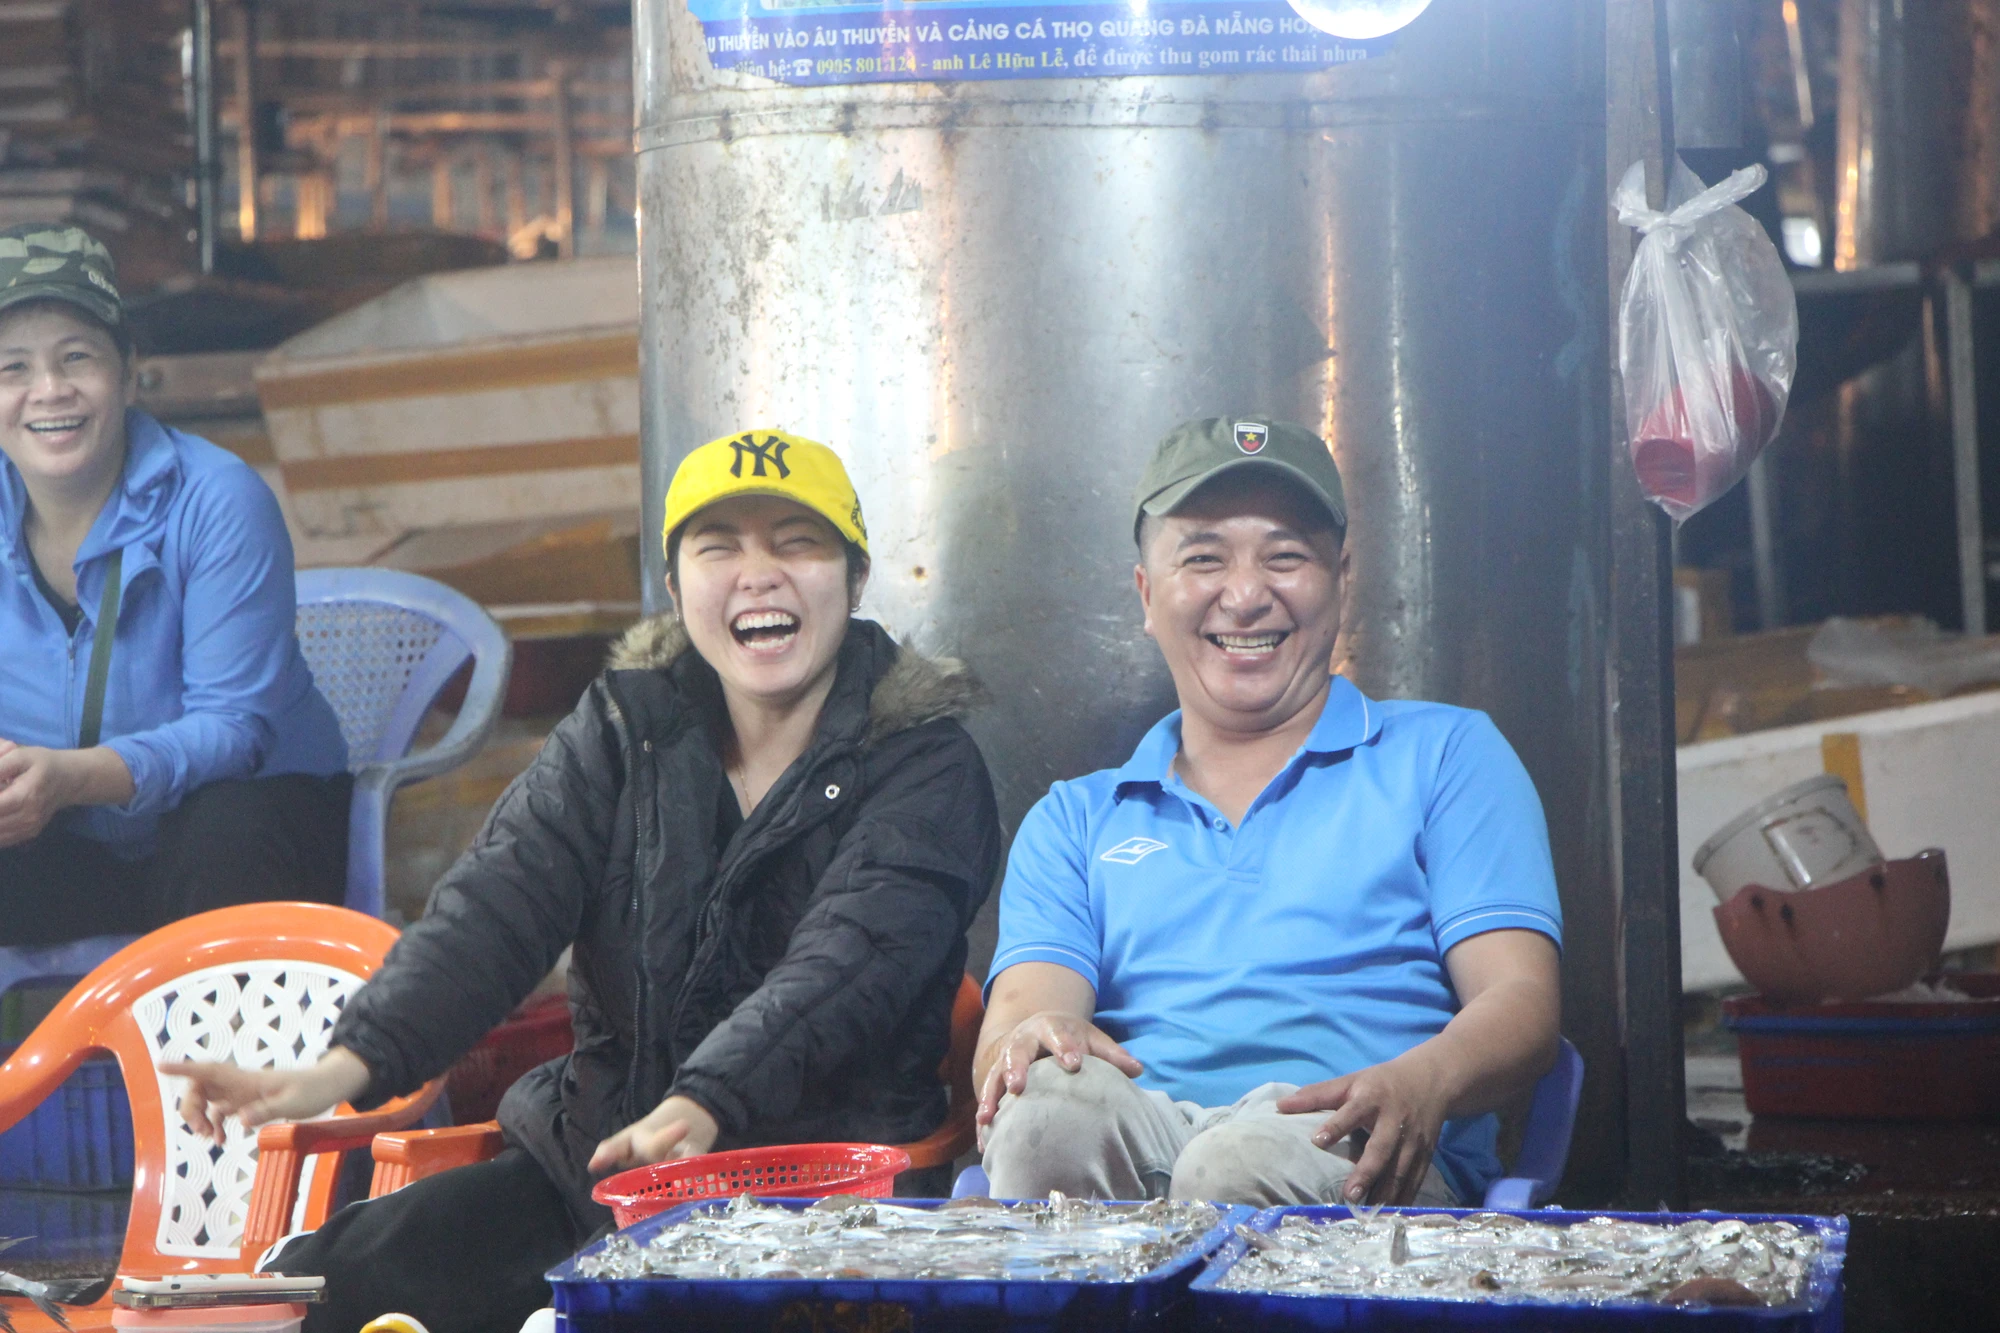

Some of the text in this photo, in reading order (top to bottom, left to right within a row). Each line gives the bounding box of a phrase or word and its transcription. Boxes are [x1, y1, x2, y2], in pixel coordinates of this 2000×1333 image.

[718, 26, 769, 52] THUYỀN
[773, 28, 809, 49] VÀO
[813, 25, 838, 47] ÂU
[842, 19, 910, 46] THUYỀN
[916, 21, 943, 43] VÀ
[948, 18, 1009, 41] CẢNG
[1015, 17, 1046, 40] CÁ
[1051, 20, 1094, 43] THỌ
[1099, 18, 1175, 39] QUANG
[1180, 14, 1210, 36] ĐÀ
[1216, 10, 1274, 35] NẴNG
[817, 58, 852, 76] 0905
[856, 57, 882, 74] 801
[890, 55, 917, 73] 124
[932, 54, 964, 71] anh
[970, 53, 991, 70] Lê
[997, 52, 1035, 70] Hữu
[1041, 47, 1069, 70] Lễ,
[1074, 43, 1097, 67] để
[1103, 47, 1153, 69] được
[1159, 47, 1193, 65] thu
[1198, 50, 1240, 69] gom
[1246, 44, 1276, 64] rác
[1282, 43, 1318, 62] thải
[728, 434, 790, 480] NY
